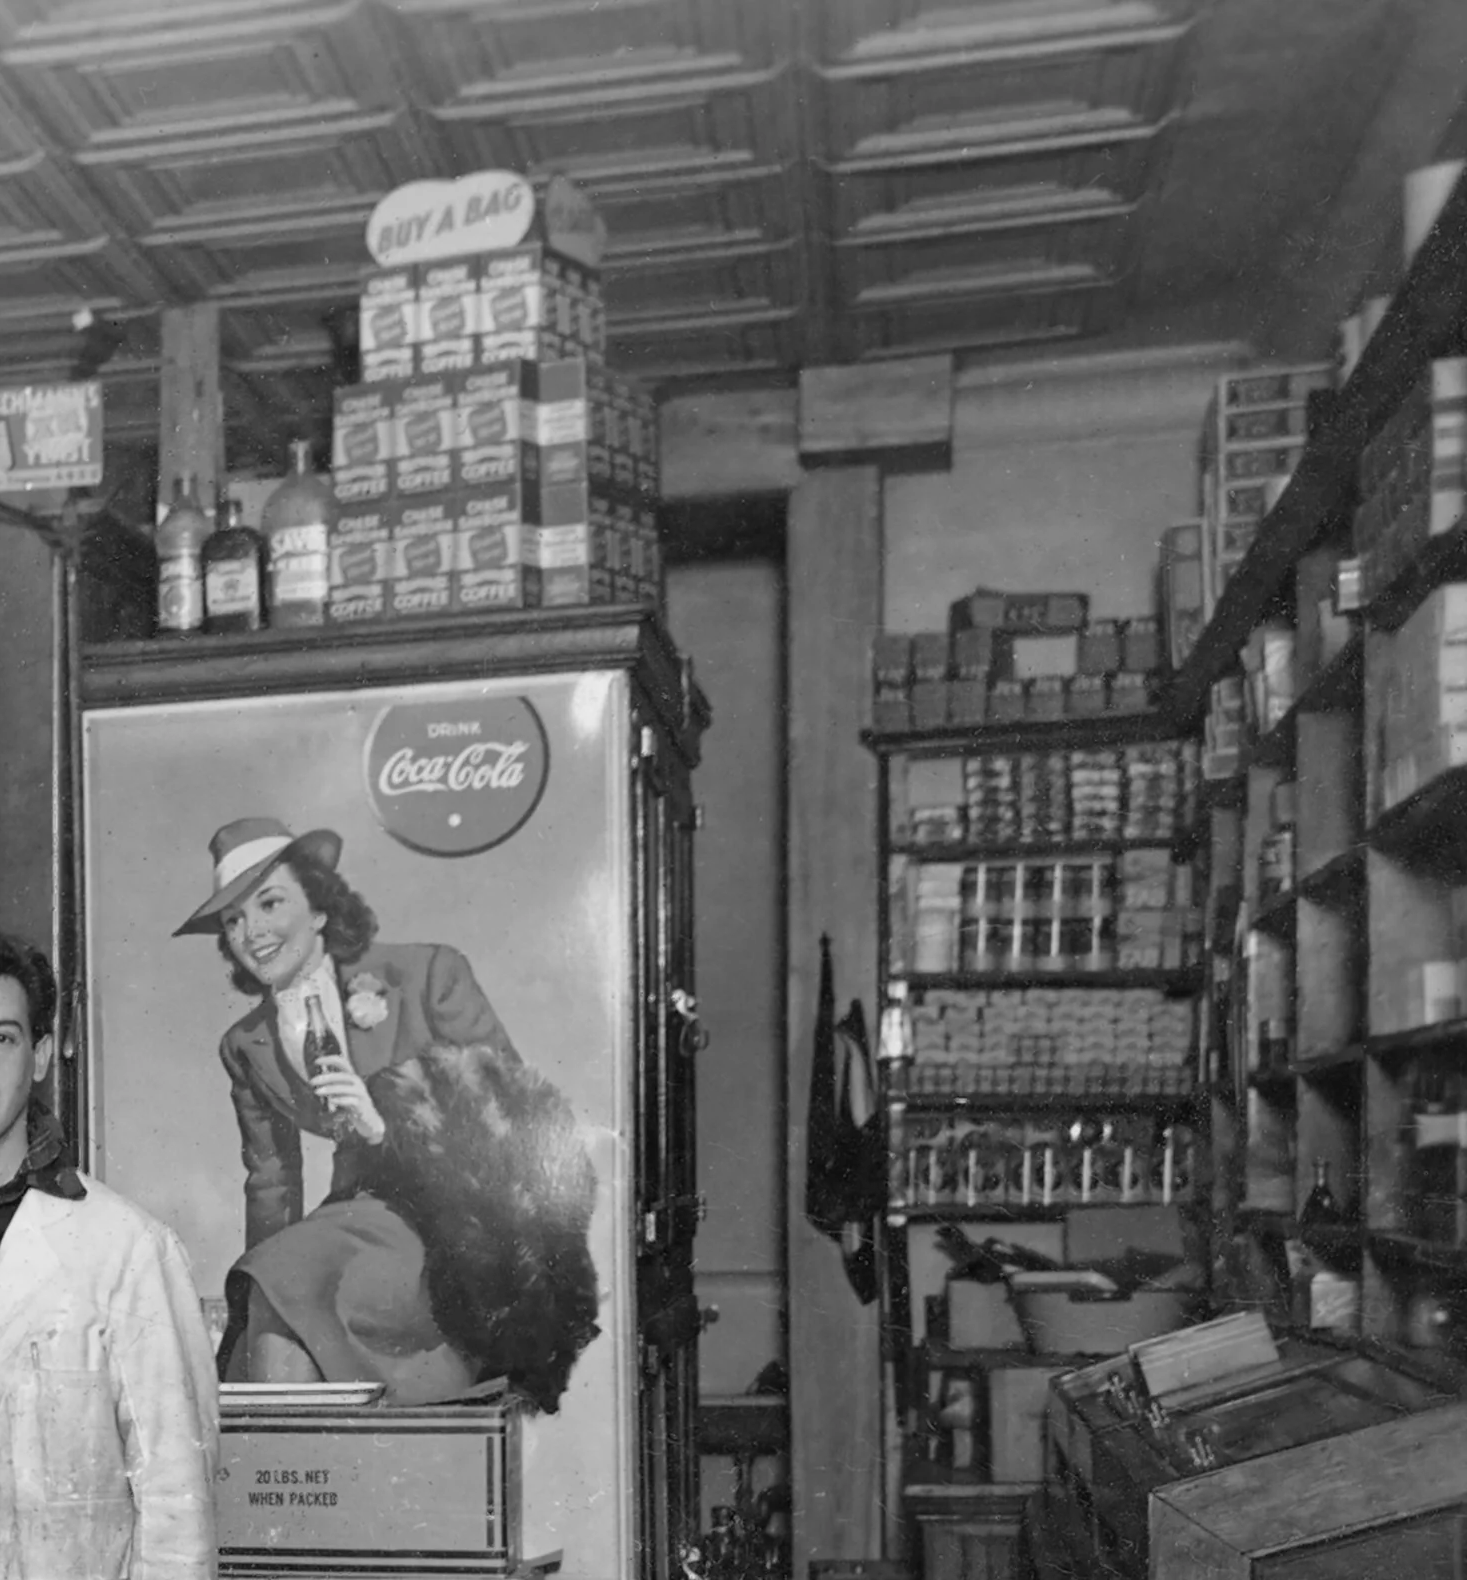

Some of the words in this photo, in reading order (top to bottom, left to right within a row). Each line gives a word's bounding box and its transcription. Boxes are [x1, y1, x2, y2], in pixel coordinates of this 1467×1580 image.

[377, 208, 434, 253] BUY
[435, 203, 455, 237] A
[463, 182, 523, 228] BAG
[397, 467, 452, 491] COFFEE
[460, 457, 517, 481] COFFEE
[393, 588, 450, 611] COFFEE
[459, 581, 517, 603] COFFEE
[427, 721, 482, 738] DRINK
[378, 740, 531, 796] Coca-Cola
[255, 1470, 272, 1485] 20
[304, 1468, 332, 1485] NET
[248, 1491, 284, 1507] WHEN
[289, 1491, 338, 1507] PACKED
